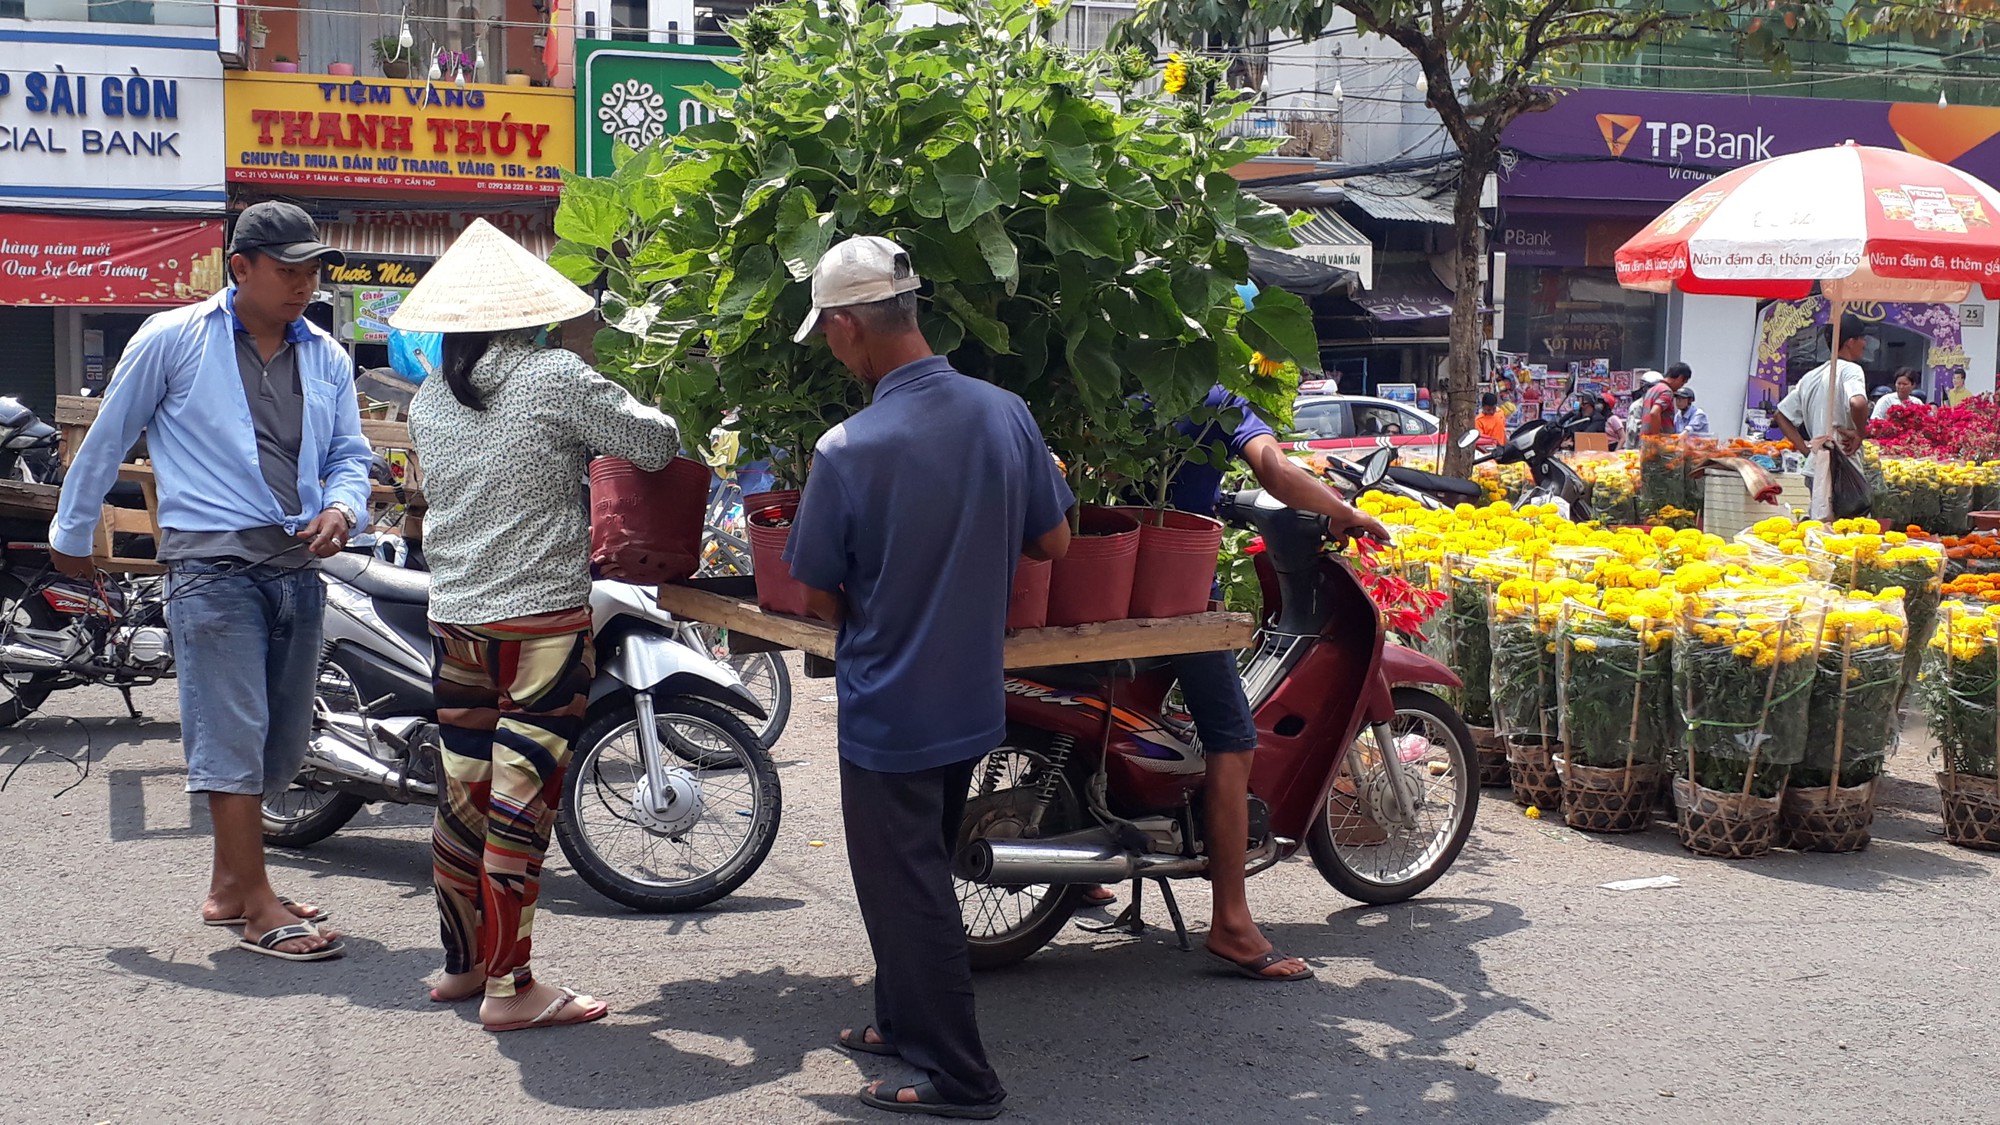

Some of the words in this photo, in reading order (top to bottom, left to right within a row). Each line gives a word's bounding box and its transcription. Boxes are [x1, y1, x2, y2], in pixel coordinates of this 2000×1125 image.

[25, 64, 87, 116] SÀI
[102, 67, 178, 119] GÒN
[319, 80, 391, 104] TIỆM
[404, 83, 485, 108] VÀNG
[82, 129, 180, 157] BANK
[252, 110, 413, 151] THANH
[427, 112, 550, 158] THÚY
[1646, 122, 1775, 160] TPBank
[241, 152, 300, 167] CHUYÊN
[304, 154, 338, 169] MUA
[343, 154, 373, 171] BÁN
[377, 157, 398, 171] NỮ
[402, 158, 452, 175] TRANG,
[458, 160, 495, 175] VÀNG
[404, 177, 421, 186] CẦN
[1504, 229, 1551, 246] PBank
[1, 238, 40, 258] hàng
[44, 243, 77, 256] năm
[82, 242, 111, 256] mới
[1328, 253, 1344, 265] VĂN
[1346, 252, 1360, 265] TẤN
[1727, 253, 1752, 269] đậm
[1844, 253, 1860, 266] bó
[1900, 253, 1928, 270] đậm
[1951, 256, 1982, 271] thêm
[2, 260, 36, 278] Vạn
[41, 260, 63, 279] Sự
[98, 260, 149, 280] Tường
[328, 263, 372, 283] Nước
[377, 262, 417, 284] Mía
[1966, 309, 1978, 319] 25
